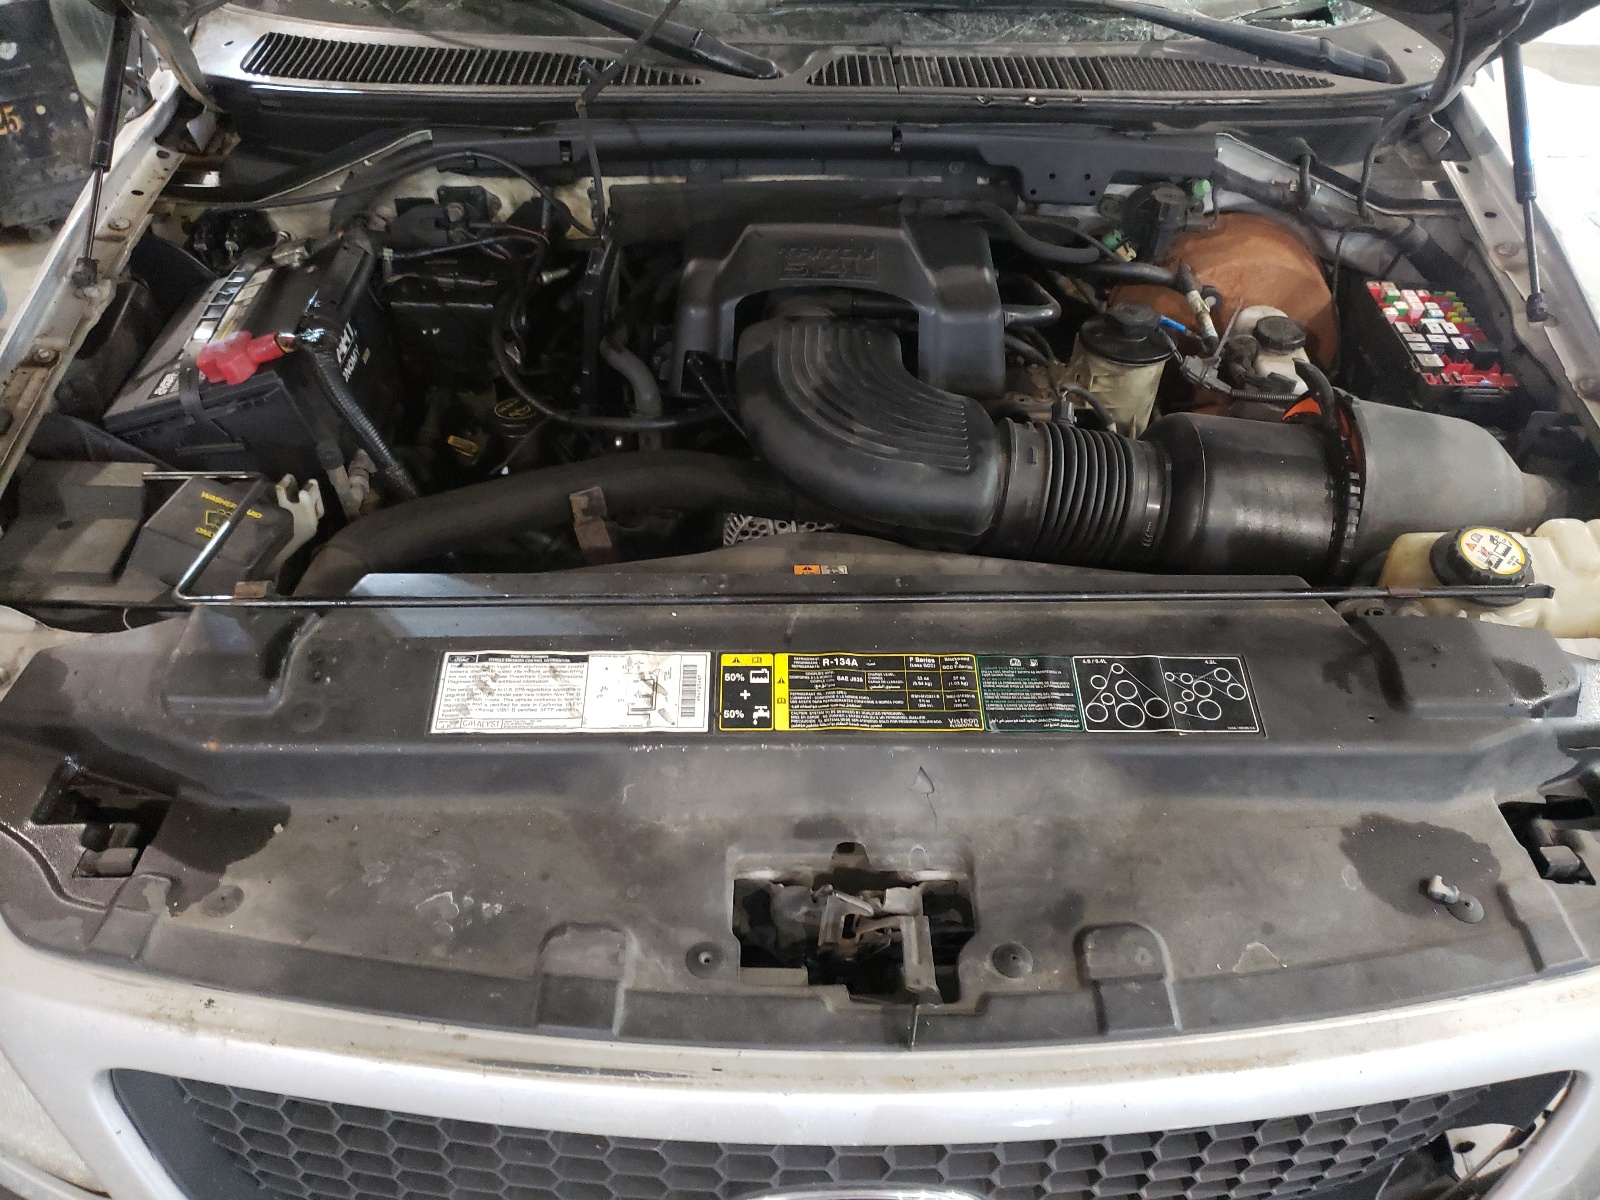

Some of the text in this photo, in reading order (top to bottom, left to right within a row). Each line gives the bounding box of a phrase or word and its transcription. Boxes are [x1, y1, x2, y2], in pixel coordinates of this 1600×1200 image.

[201, 491, 238, 509] WASHER
[822, 657, 859, 667] R-134A
[724, 673, 745, 682] 50%
[723, 709, 745, 719] 50%
[948, 717, 979, 725] Visteon
